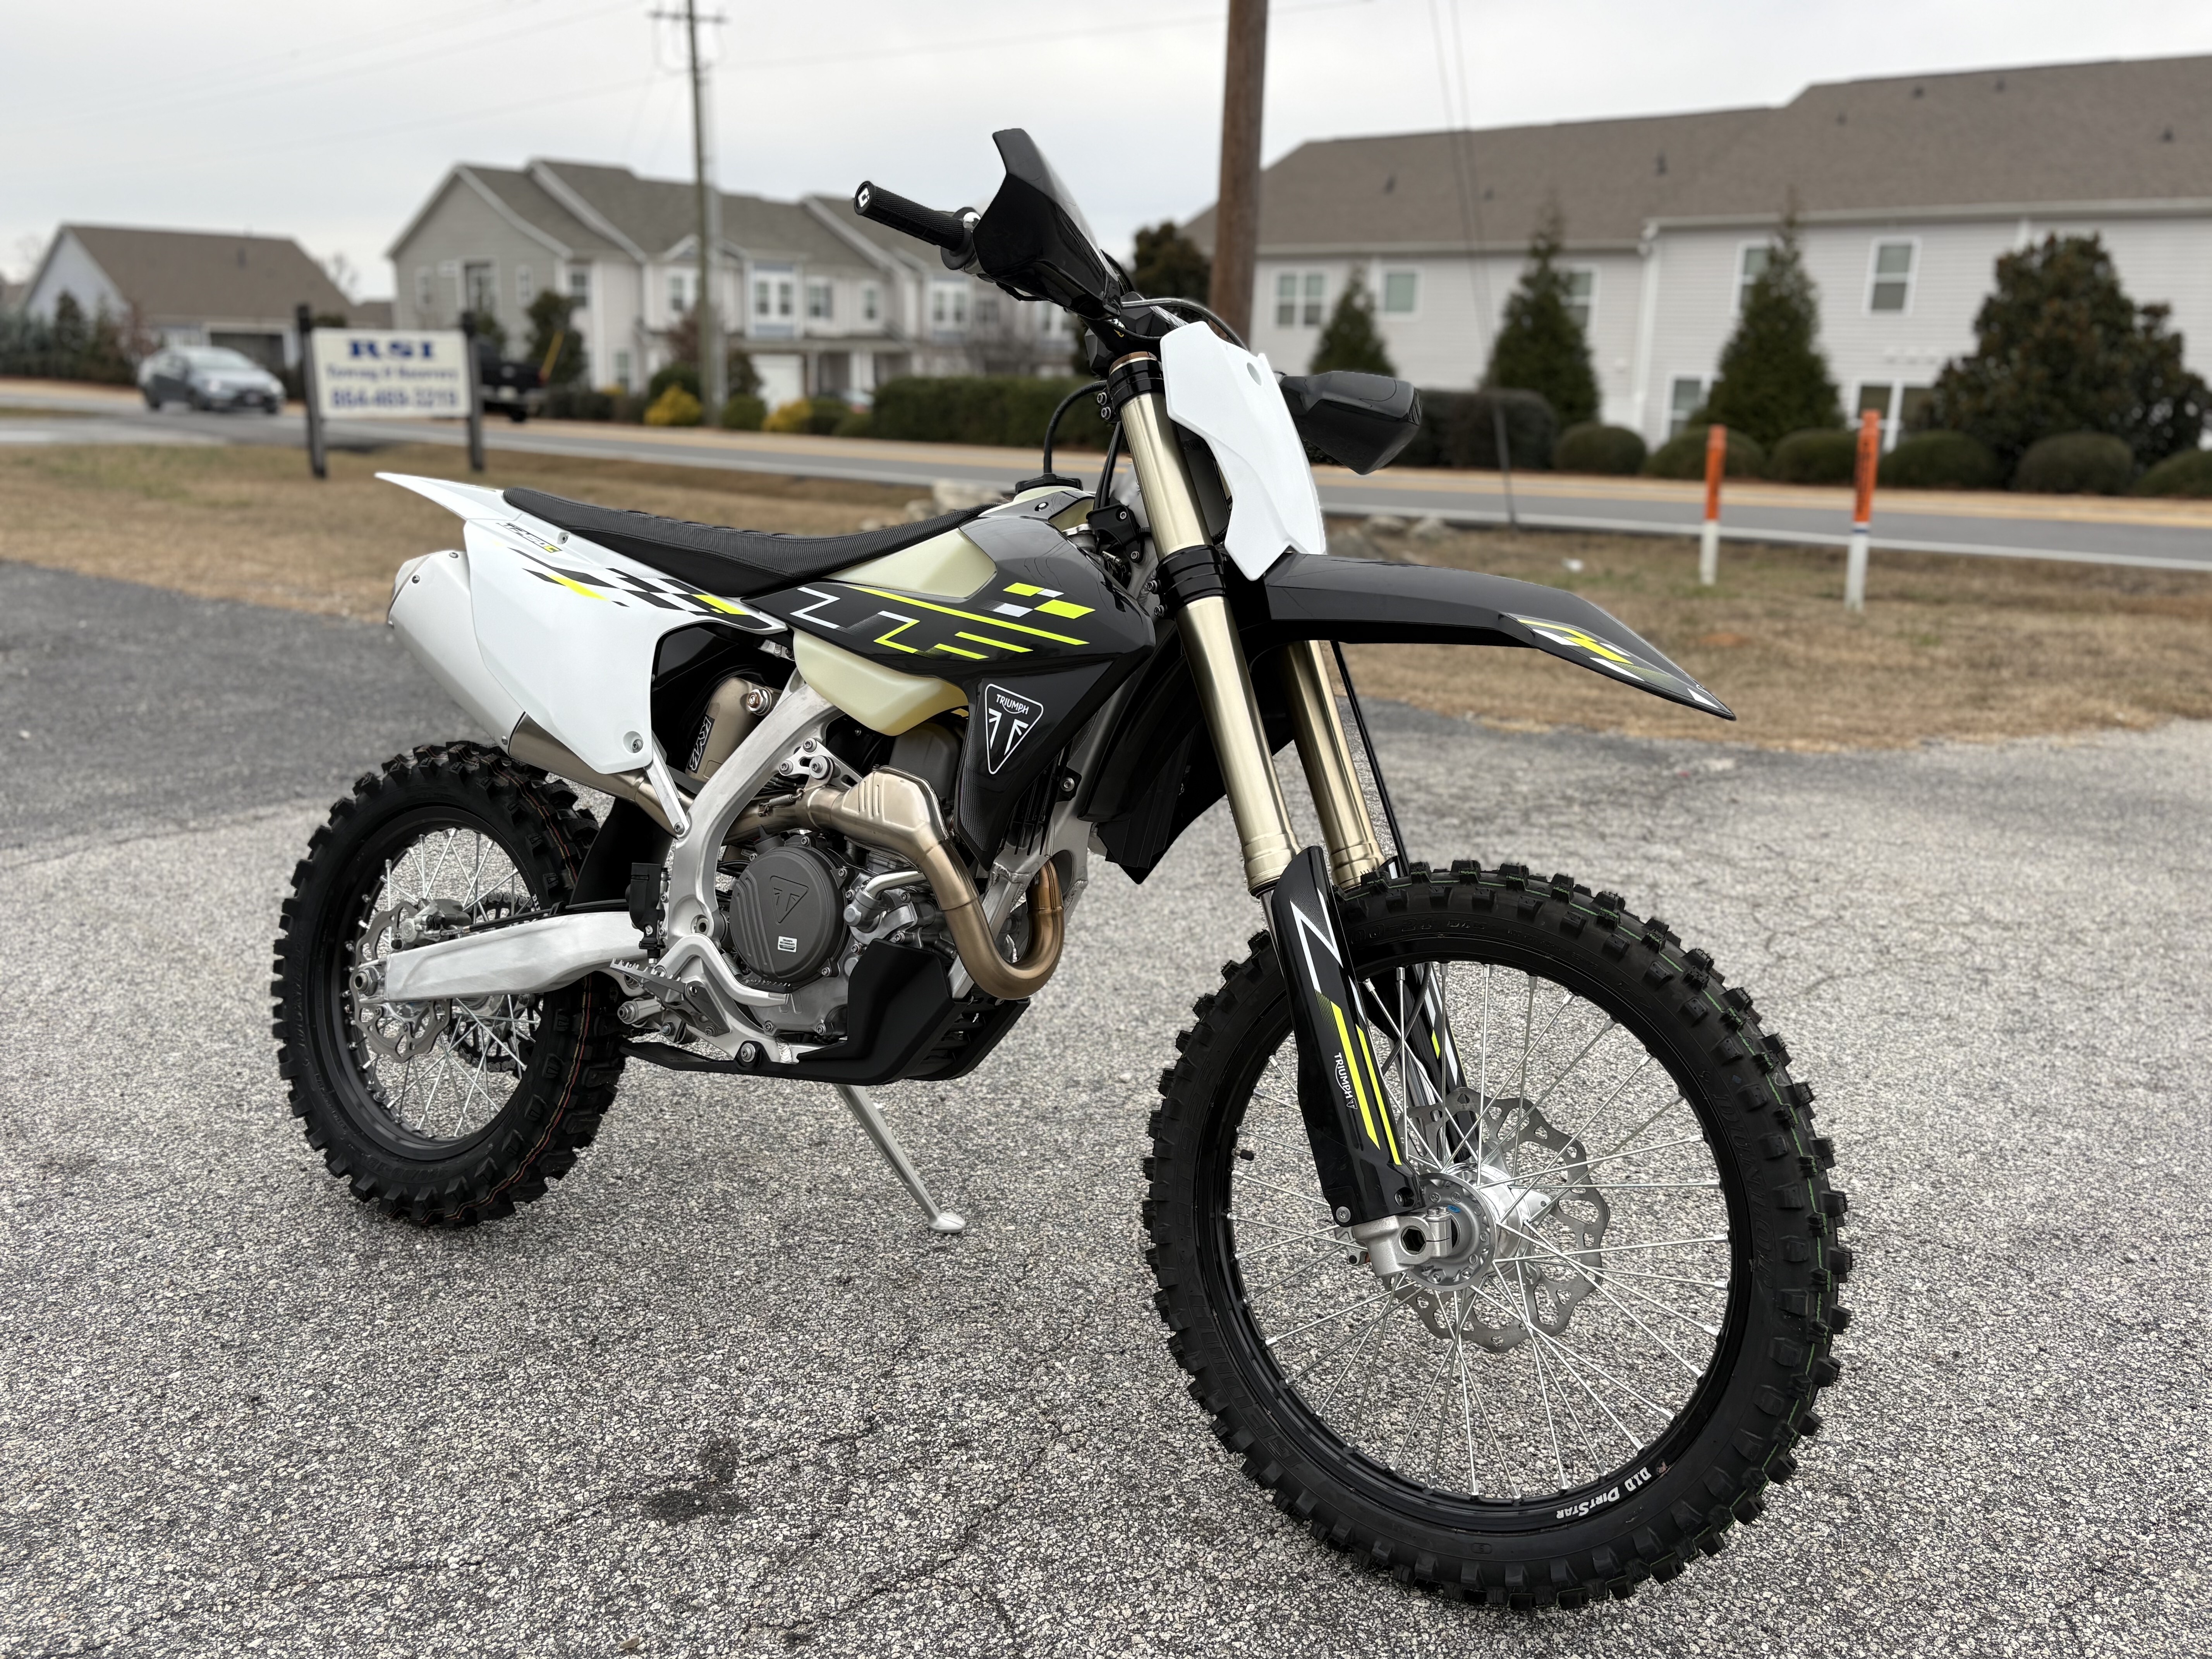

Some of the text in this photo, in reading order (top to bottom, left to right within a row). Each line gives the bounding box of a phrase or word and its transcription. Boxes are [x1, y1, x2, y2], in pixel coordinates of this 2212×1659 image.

[350, 342, 433, 359] RSI
[996, 694, 1029, 714] TRIUMPH
[689, 716, 711, 771] KYB
[1334, 1052, 1353, 1099] TRIUMPH
[1712, 1092, 1774, 1289] DUNLOP
